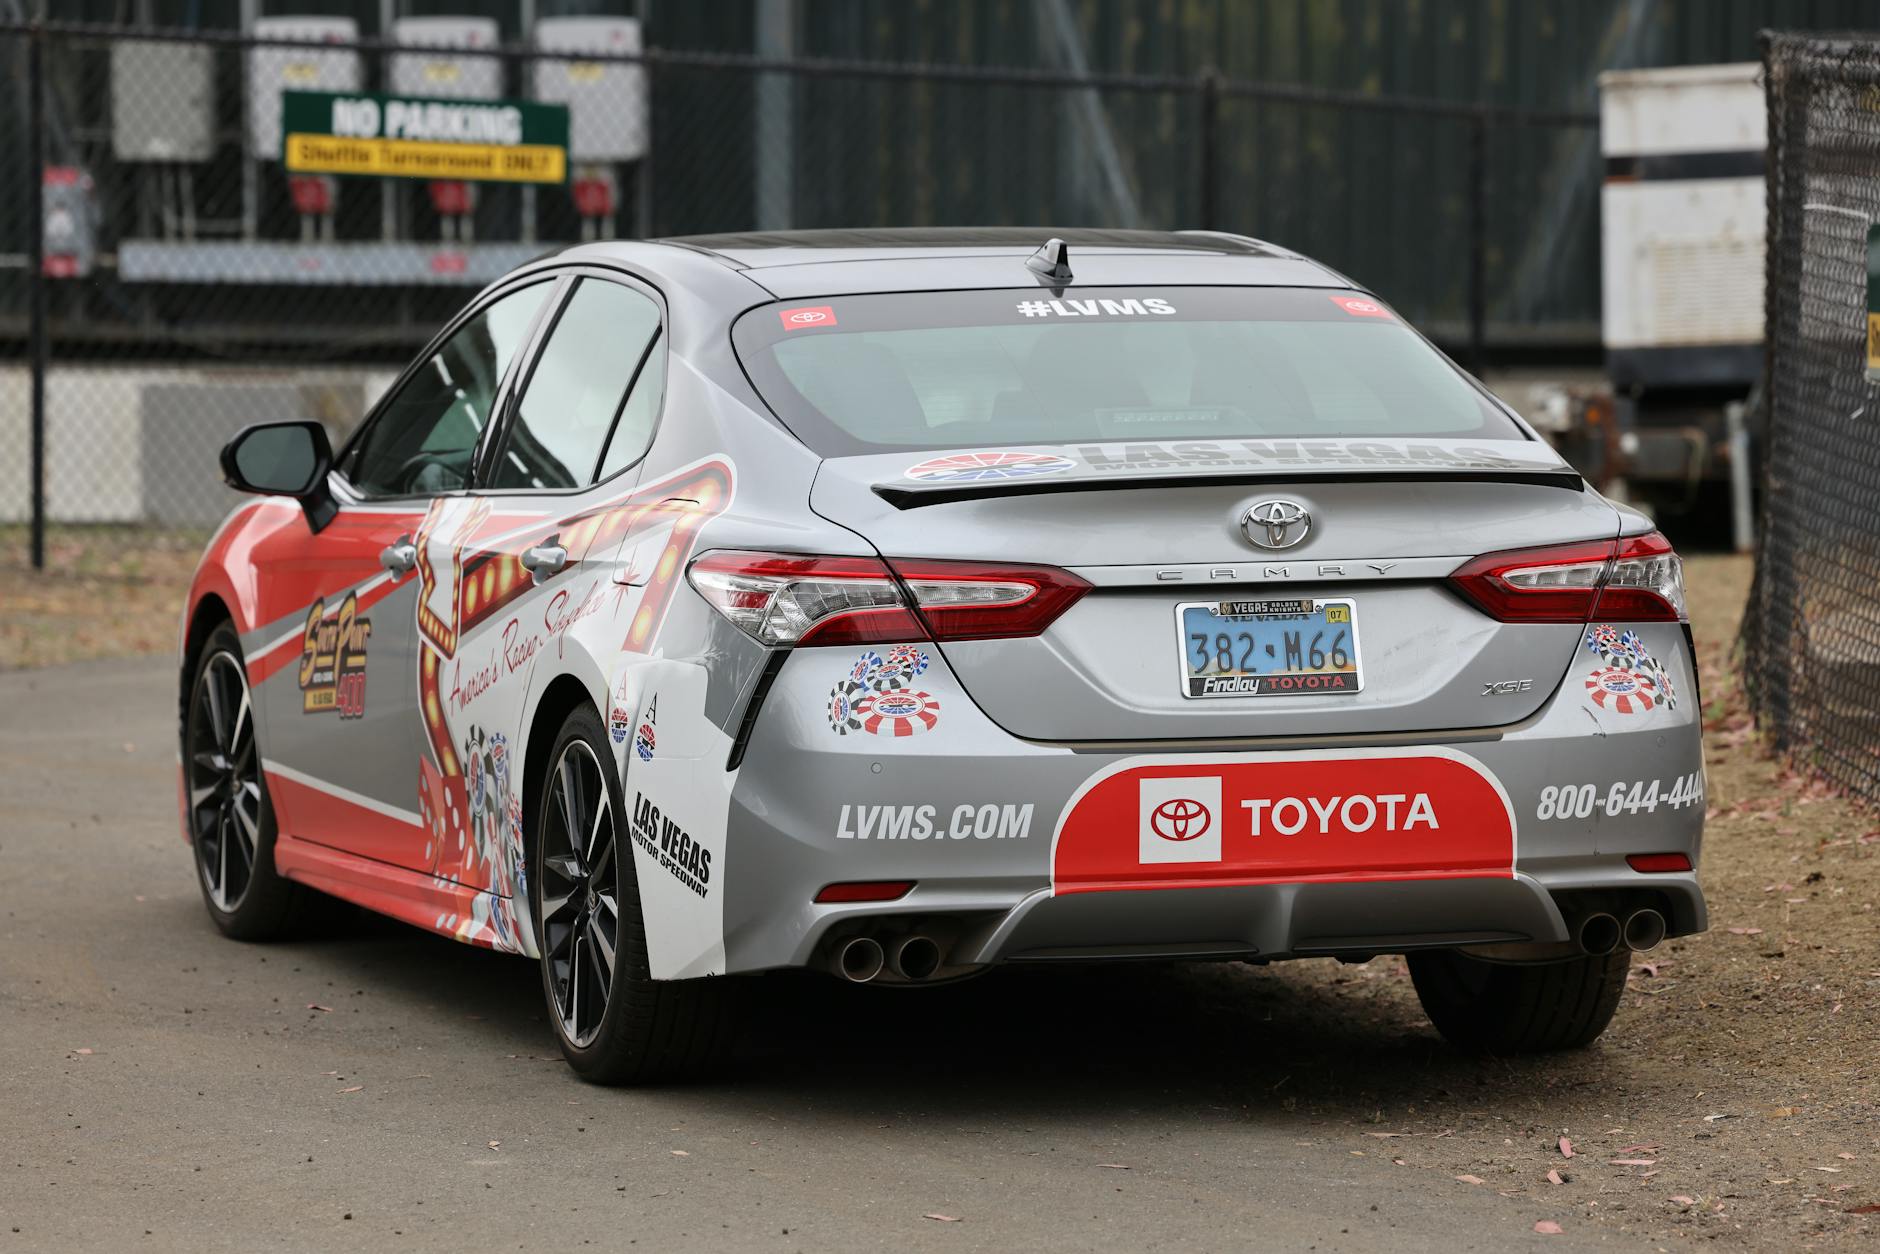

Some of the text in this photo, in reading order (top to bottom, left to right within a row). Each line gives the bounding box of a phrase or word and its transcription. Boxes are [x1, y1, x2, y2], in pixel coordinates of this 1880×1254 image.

[332, 97, 523, 147] NO PARKING
[301, 143, 371, 163] Shuttle
[380, 147, 493, 169] Turnaround
[1016, 298, 1177, 317] #LVMS
[1078, 441, 1514, 466] LAS VEGAS
[1157, 564, 1398, 581] CAMRY
[1233, 602, 1268, 613] VEGAS
[1330, 610, 1341, 620] 07
[1191, 630, 1348, 674] 382 M66
[336, 672, 366, 717] 400
[449, 648, 499, 717] America's
[615, 671, 628, 702] A
[1203, 676, 1345, 693] Findlay TOYOTA
[1481, 679, 1533, 696] XSE
[645, 692, 658, 726] A
[836, 803, 1034, 840] LVMS.COM
[1241, 793, 1439, 836] TOYOTA
[633, 791, 712, 884] LAS VEGAS
[631, 826, 709, 899] MOTOR SPEEDWAY
